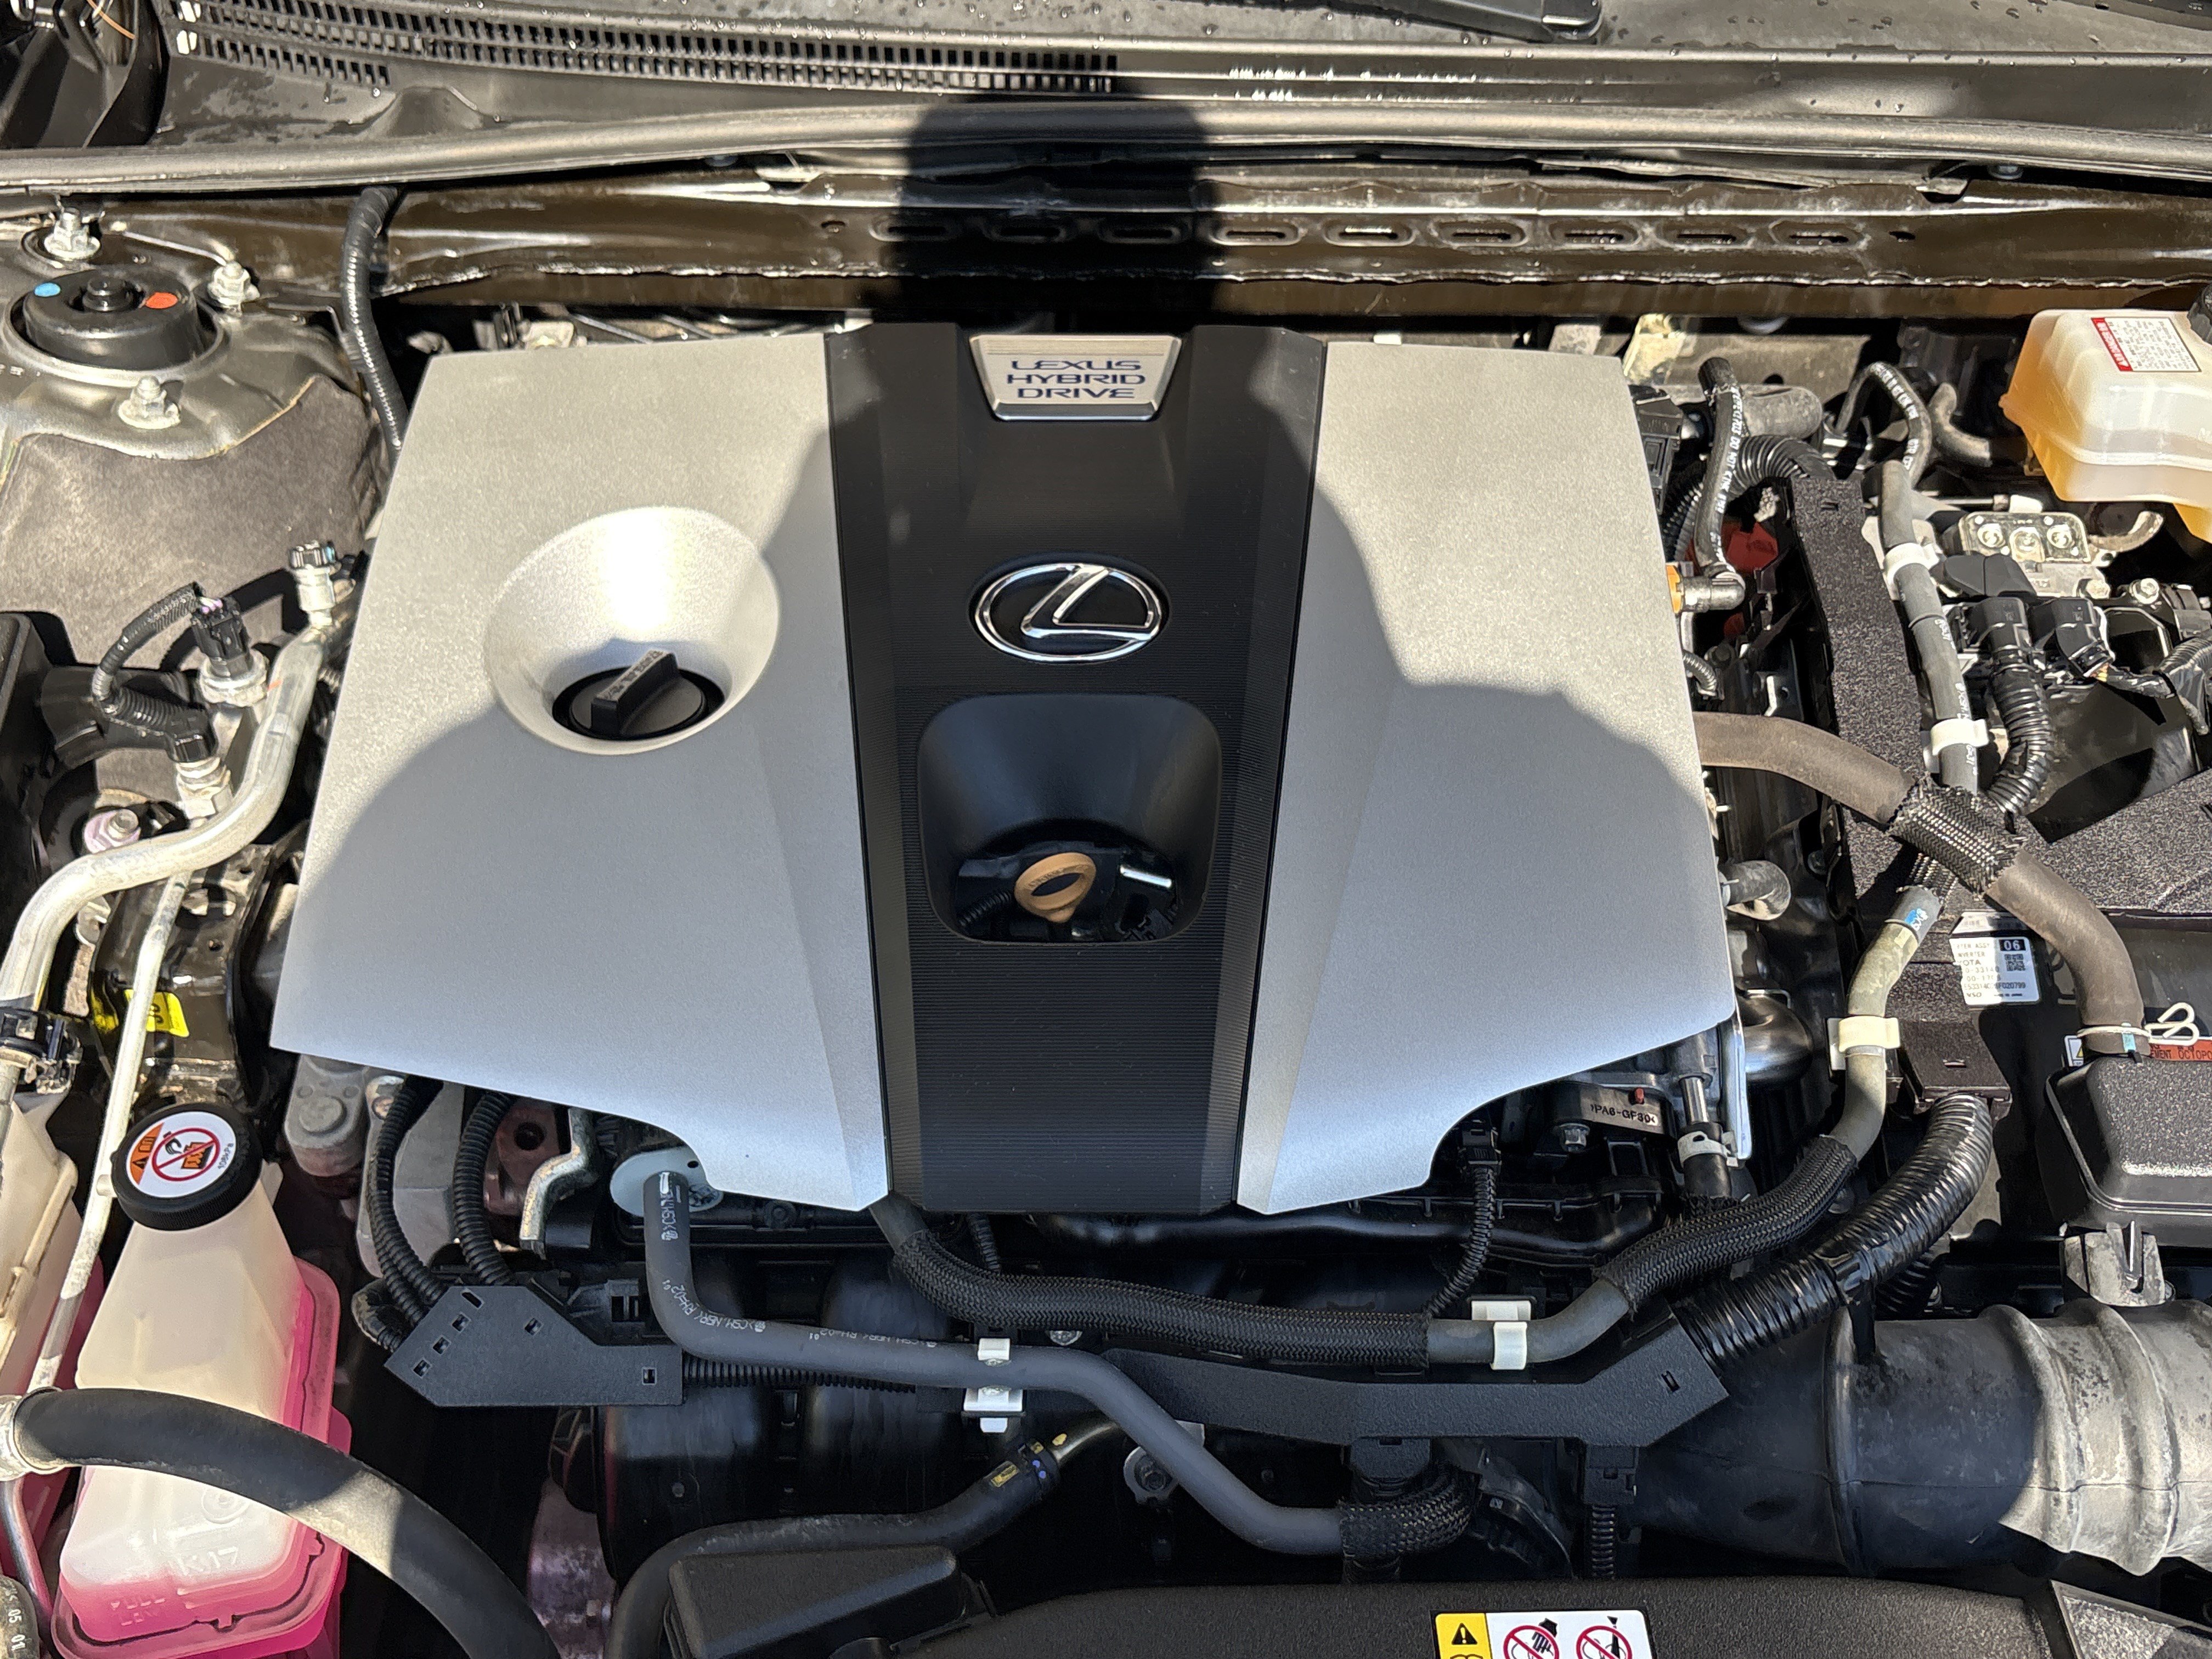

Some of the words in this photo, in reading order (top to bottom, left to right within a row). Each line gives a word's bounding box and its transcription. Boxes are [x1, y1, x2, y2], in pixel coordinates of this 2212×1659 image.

[1011, 360, 1141, 370] LEXUS
[1007, 374, 1146, 385] HYBRID
[1018, 388, 1135, 398] DRIVE
[2004, 940, 2021, 951] 06
[8, 1608, 22, 1624] 05
[11, 1634, 26, 1651] 01
